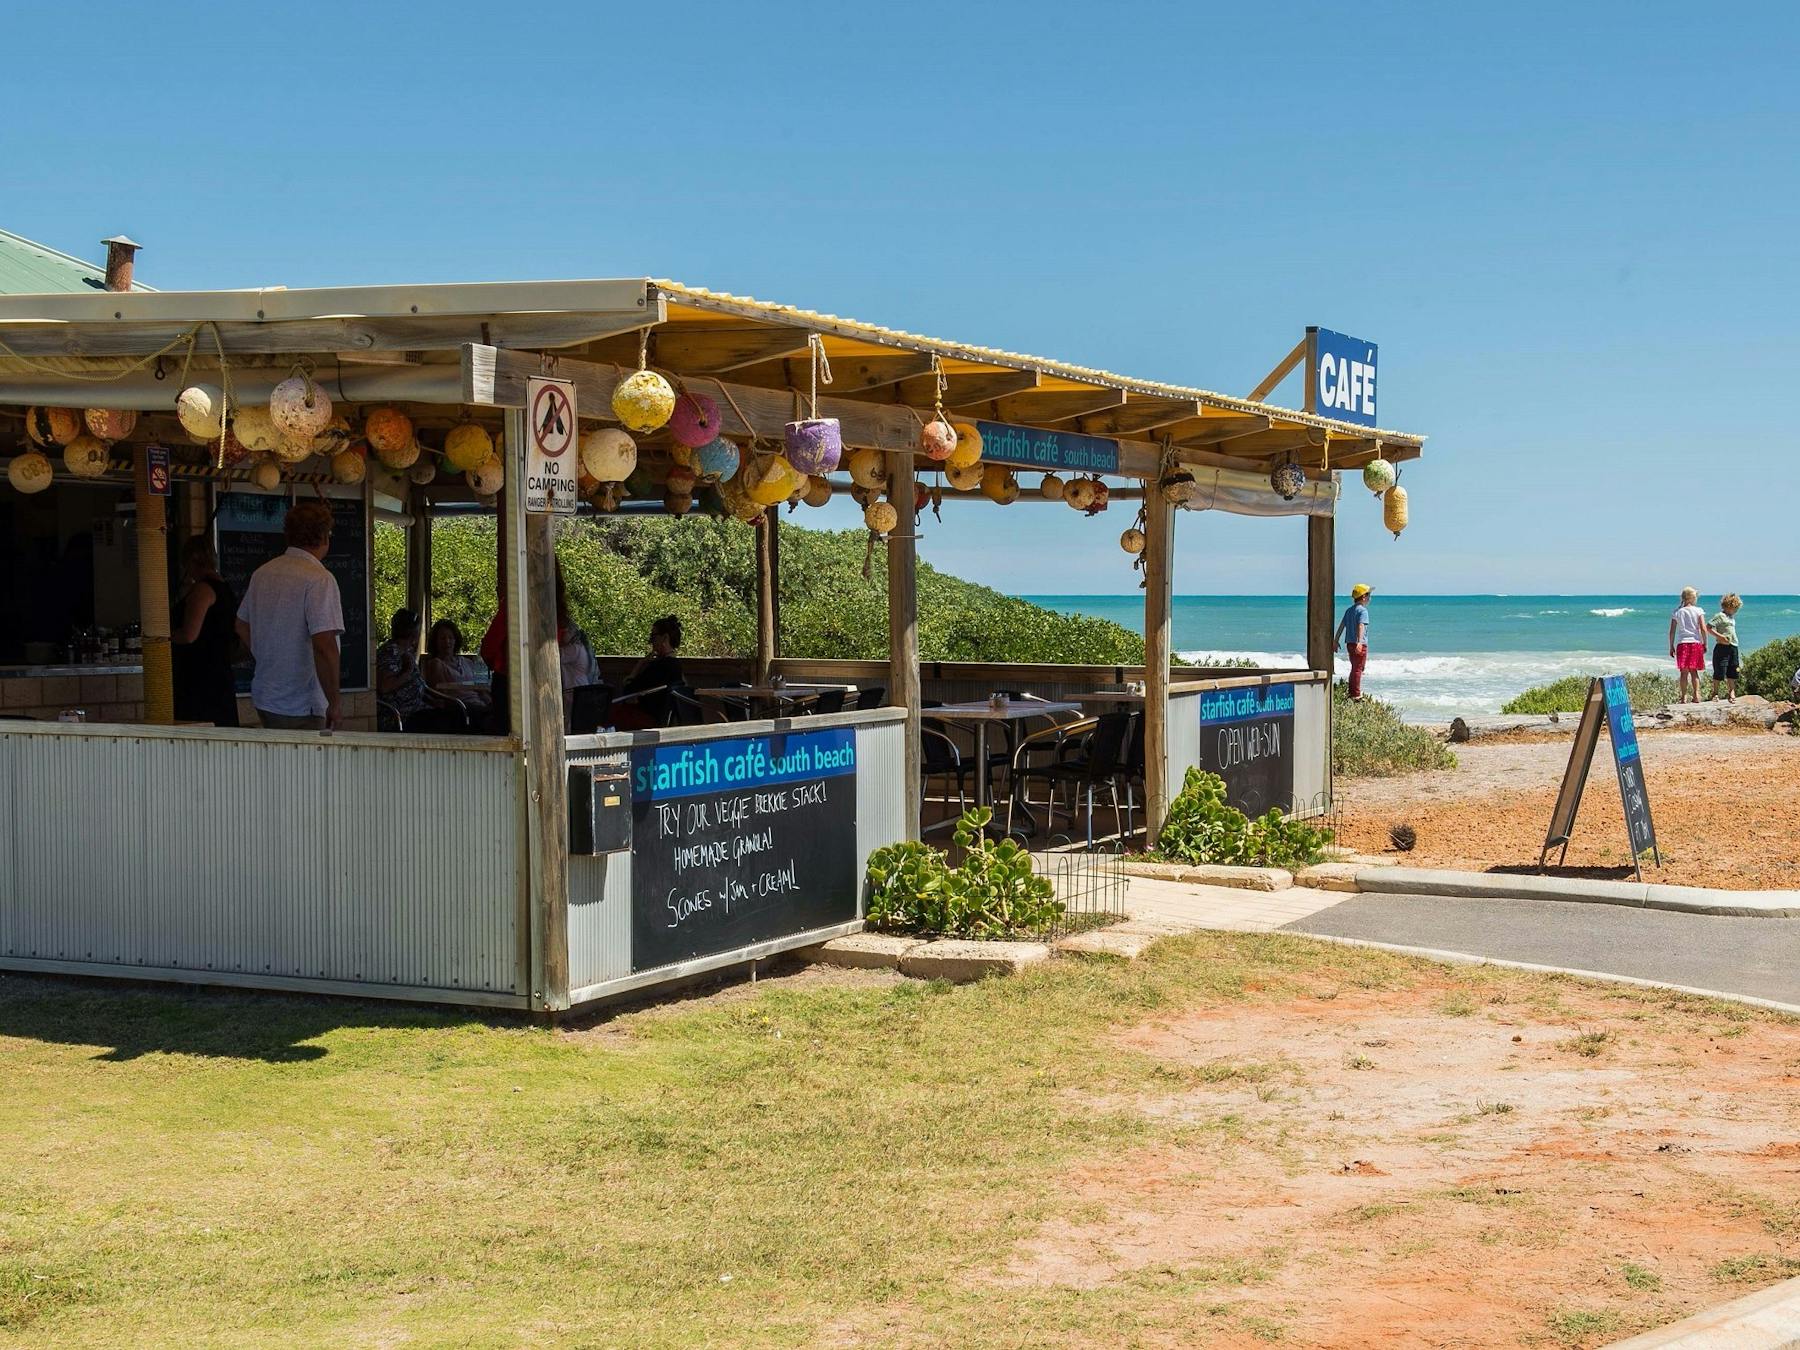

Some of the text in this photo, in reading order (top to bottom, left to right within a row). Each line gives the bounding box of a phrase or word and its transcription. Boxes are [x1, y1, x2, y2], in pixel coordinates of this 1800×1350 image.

[1320, 349, 1375, 416] CAFÉ
[544, 461, 559, 475] NO
[982, 430, 1115, 469] starfish café south beach
[528, 477, 575, 492] CAMPING
[1202, 690, 1294, 720] starfish café south beach
[636, 741, 854, 793] starfish café south beach
[1218, 727, 1244, 769] OPEN
[655, 781, 827, 839] TRY OUR VEGGIE BREKKIE STACK!
[674, 826, 773, 876] HOMEMADE GRANOLA!
[667, 887, 712, 928] SCONES
